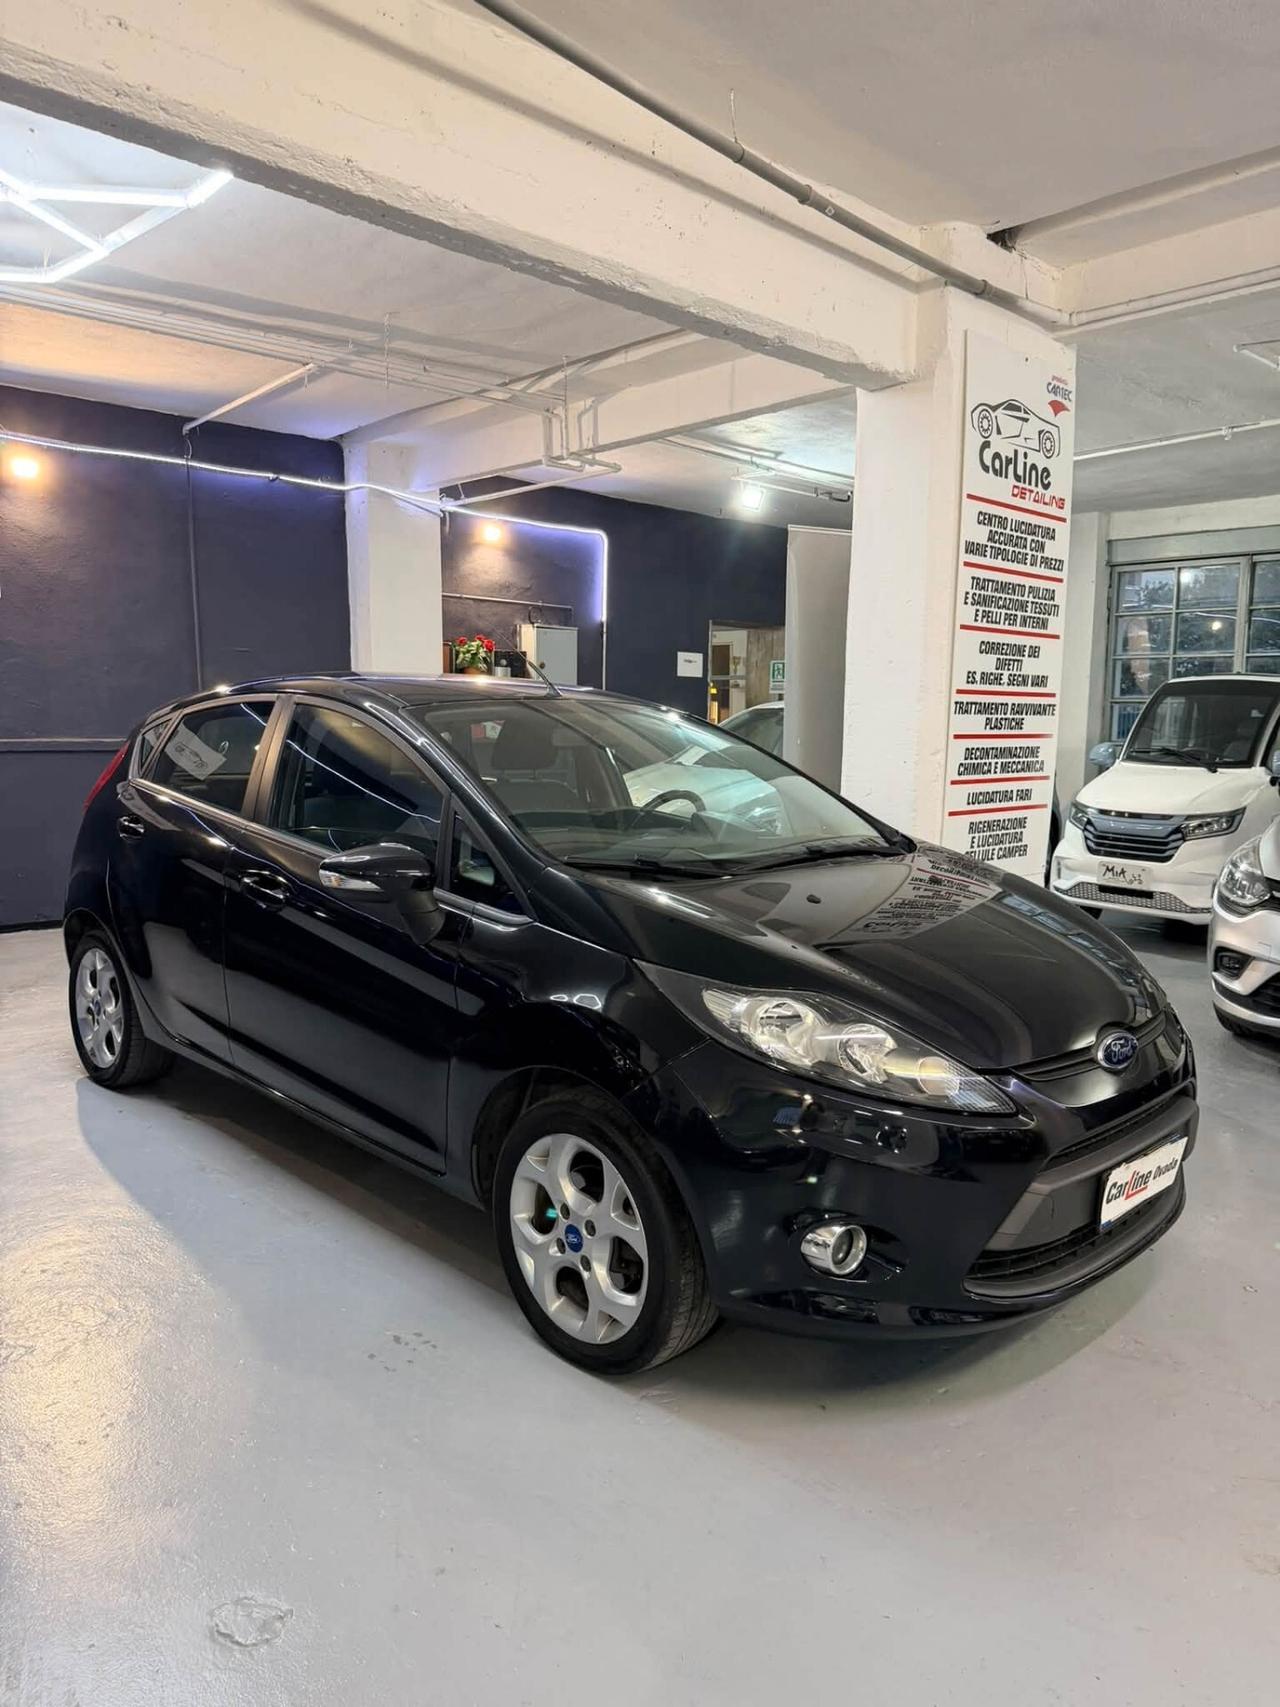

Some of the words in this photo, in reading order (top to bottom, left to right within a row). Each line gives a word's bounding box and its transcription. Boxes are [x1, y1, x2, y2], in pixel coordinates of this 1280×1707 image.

[978, 440, 1052, 491] CarLine
[1010, 484, 1066, 510] DETAILING
[977, 511, 1008, 531] CENTRO
[1010, 518, 1056, 541] LUCIDATURA
[987, 529, 1028, 549] ACCURATA
[1029, 538, 1046, 554] CON
[964, 540, 988, 558] VARIE
[989, 544, 1028, 566] TIPOLOGIE
[1029, 553, 1039, 567] DI
[1039, 556, 1065, 572] PREZZI
[970, 576, 1026, 597] TRATTAMENTO
[1027, 586, 1056, 602] PULIZIA
[963, 591, 970, 605] E
[970, 591, 1029, 614] SANIFICAZIONE
[1030, 602, 1060, 617] TESSUTI
[974, 609, 980, 623] E
[980, 609, 1002, 625] PELLI
[1003, 612, 1018, 628] PER
[1019, 615, 1049, 631] INTERNI
[979, 640, 1026, 658] CORREZIONE
[1027, 645, 1041, 659] DEI
[995, 658, 1024, 672] DIFETTI
[1006, 673, 1030, 688] SEGNI
[1030, 675, 1049, 688] VARI
[954, 701, 1009, 716] TRATTAMENTO
[1009, 703, 1057, 716] RAVVIVANTE
[984, 717, 1024, 731] PLASTICHE
[963, 746, 1041, 761] DECONTAMINAZIONE
[957, 762, 992, 776] CHIMICA
[993, 761, 999, 775] E
[999, 760, 1045, 774] MECCANICA
[966, 789, 1015, 806] LUCIDATURA
[1015, 788, 1033, 802] FARI
[968, 816, 1028, 835] RIGENERAZIONE
[970, 836, 976, 849] E
[977, 831, 1024, 848] LUCIDATURA
[996, 844, 1029, 860] CAMPER
[1110, 1038, 1133, 1062] Ford
